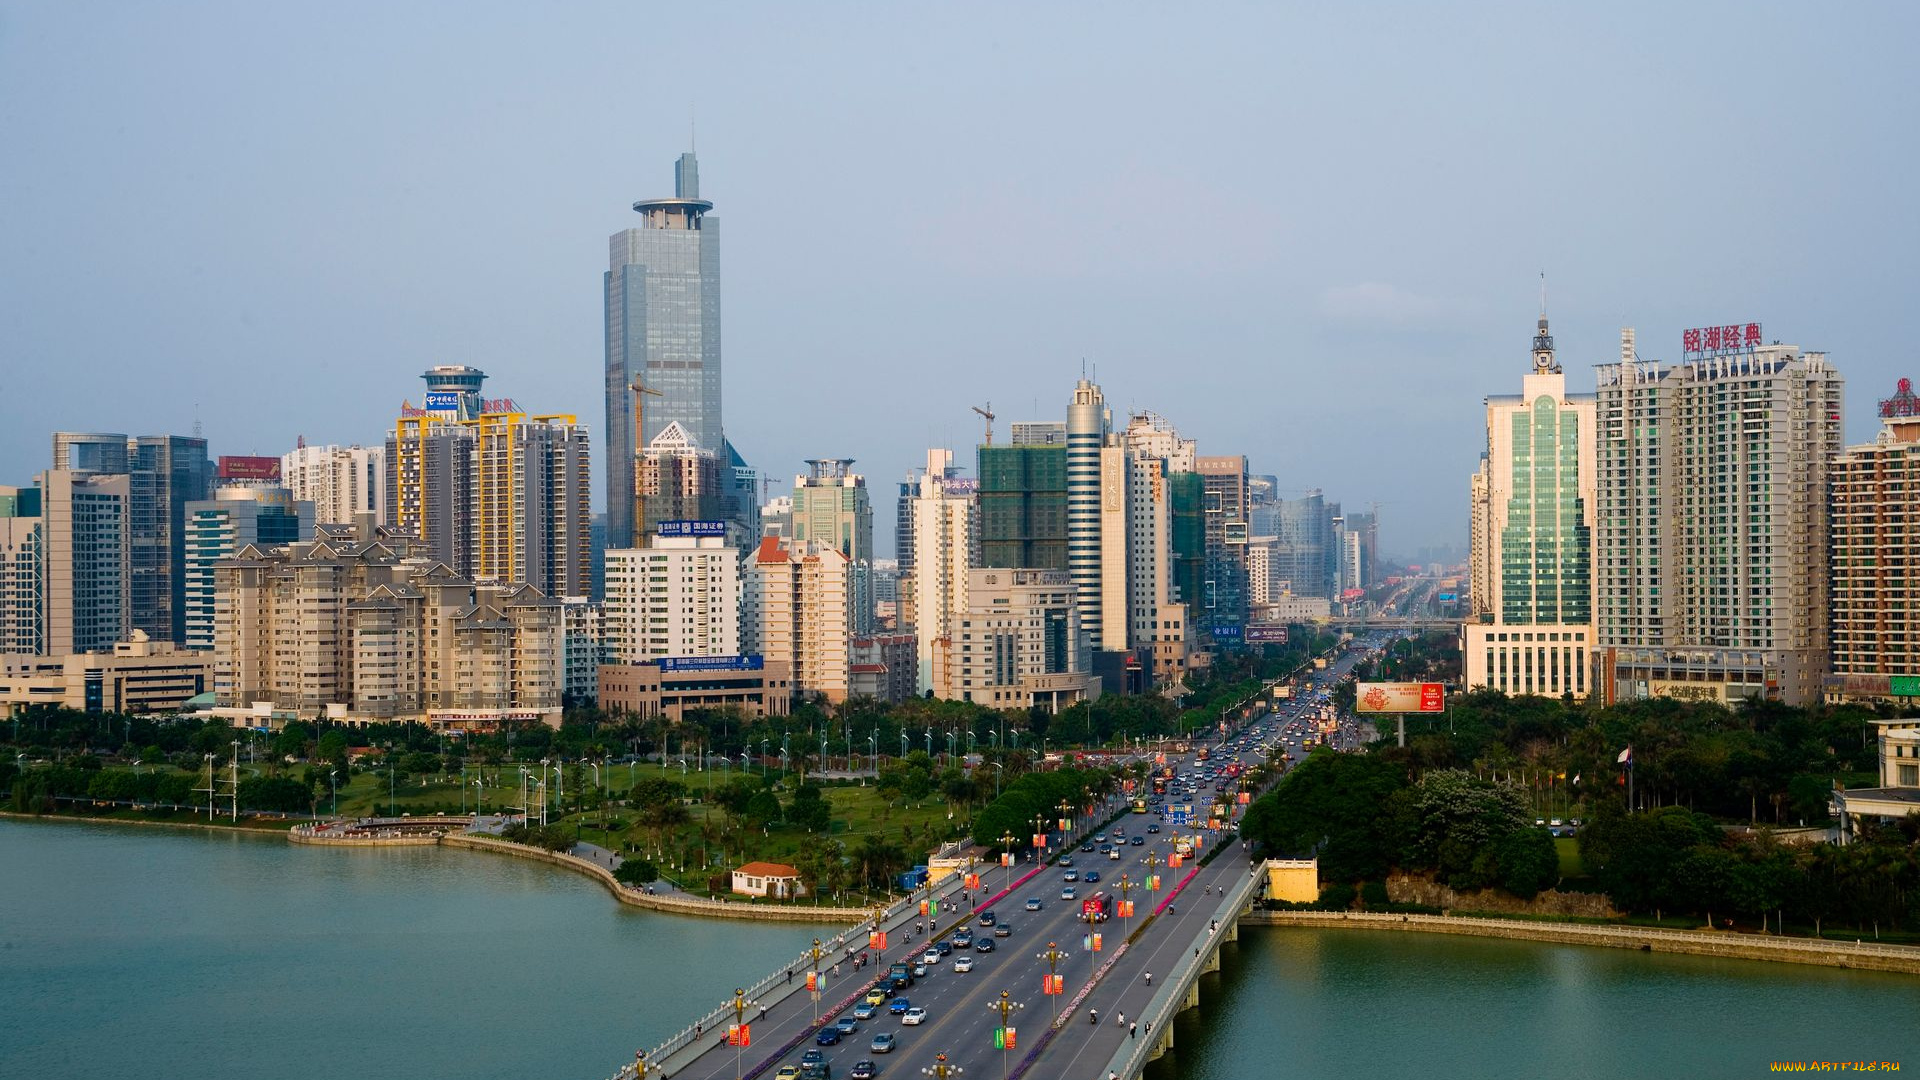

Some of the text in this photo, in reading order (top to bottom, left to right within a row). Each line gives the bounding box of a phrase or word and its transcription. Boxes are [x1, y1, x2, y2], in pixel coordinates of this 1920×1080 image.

[1683, 323, 1761, 353] 铭湖经典
[693, 522, 724, 530] 国海证券
